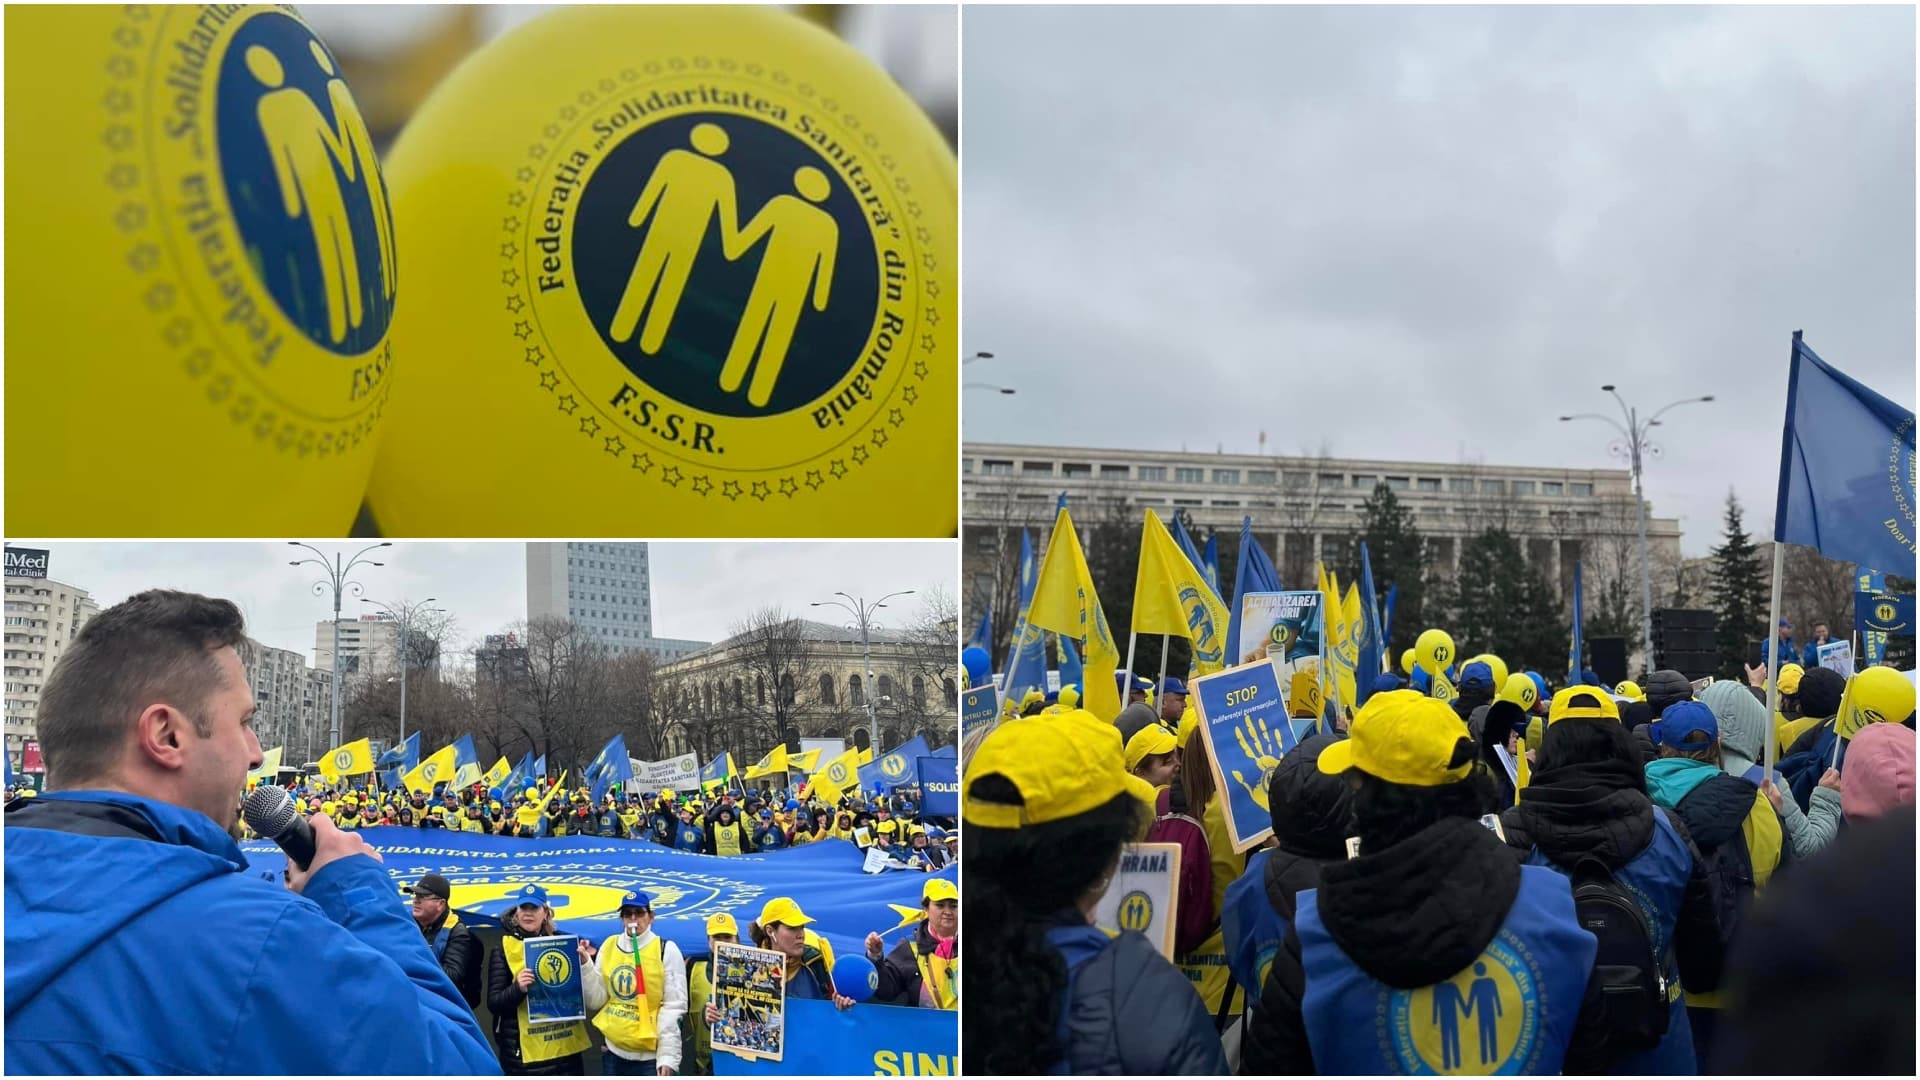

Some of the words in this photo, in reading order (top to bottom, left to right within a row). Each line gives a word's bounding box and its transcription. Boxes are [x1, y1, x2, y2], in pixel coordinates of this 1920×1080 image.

[535, 148, 590, 295] Federația
[883, 247, 907, 304] din
[810, 315, 905, 431] România
[608, 381, 726, 455] F.S.S.R.
[1883, 518, 1911, 545] Doar
[19, 568, 46, 577] Clinic
[1247, 595, 1317, 608] ACTUALIZAREA
[1226, 685, 1258, 707] STOP
[1121, 852, 1168, 873] HRANĂ
